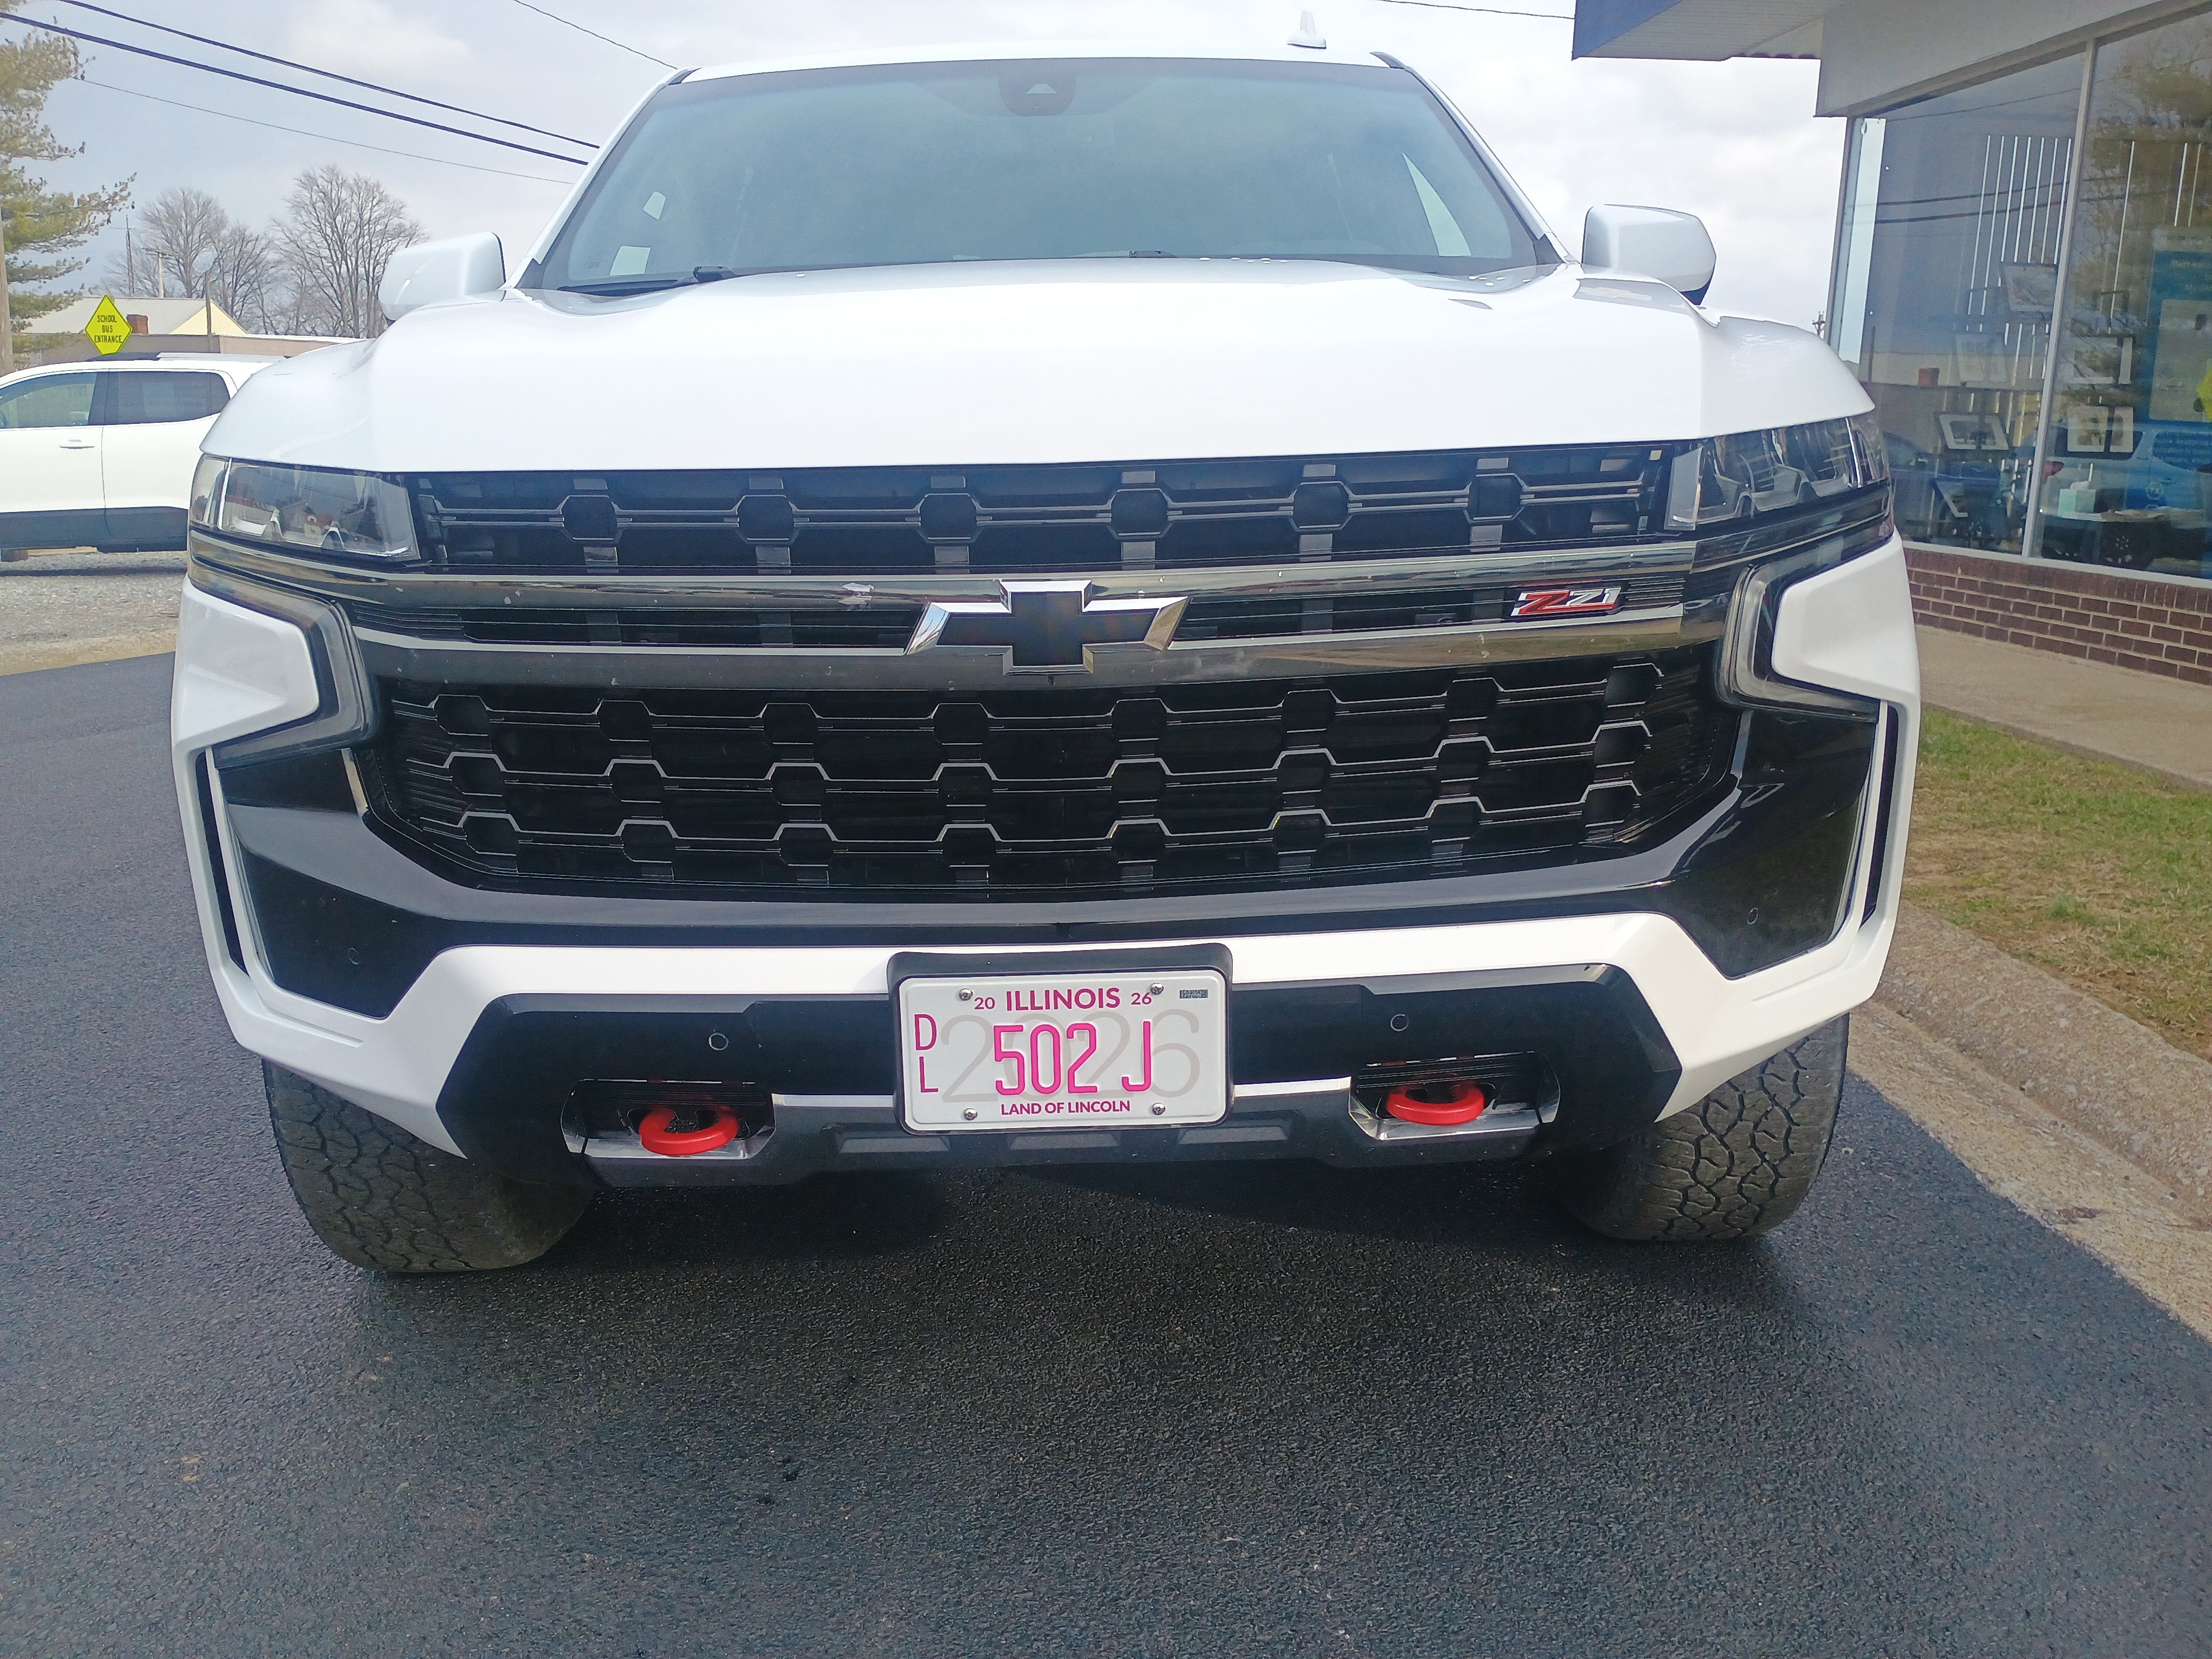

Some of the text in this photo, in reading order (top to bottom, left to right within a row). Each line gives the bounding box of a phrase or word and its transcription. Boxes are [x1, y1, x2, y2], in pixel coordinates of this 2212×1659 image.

[97, 315, 117, 323] SCHOOL
[102, 325, 113, 333] BUS
[1511, 587, 1622, 616] Z71
[974, 987, 1152, 1011] 20 ILLINOIS 26
[993, 1021, 1152, 1096] 502 J
[1001, 1100, 1130, 1115] LAND OF LINCOLN
